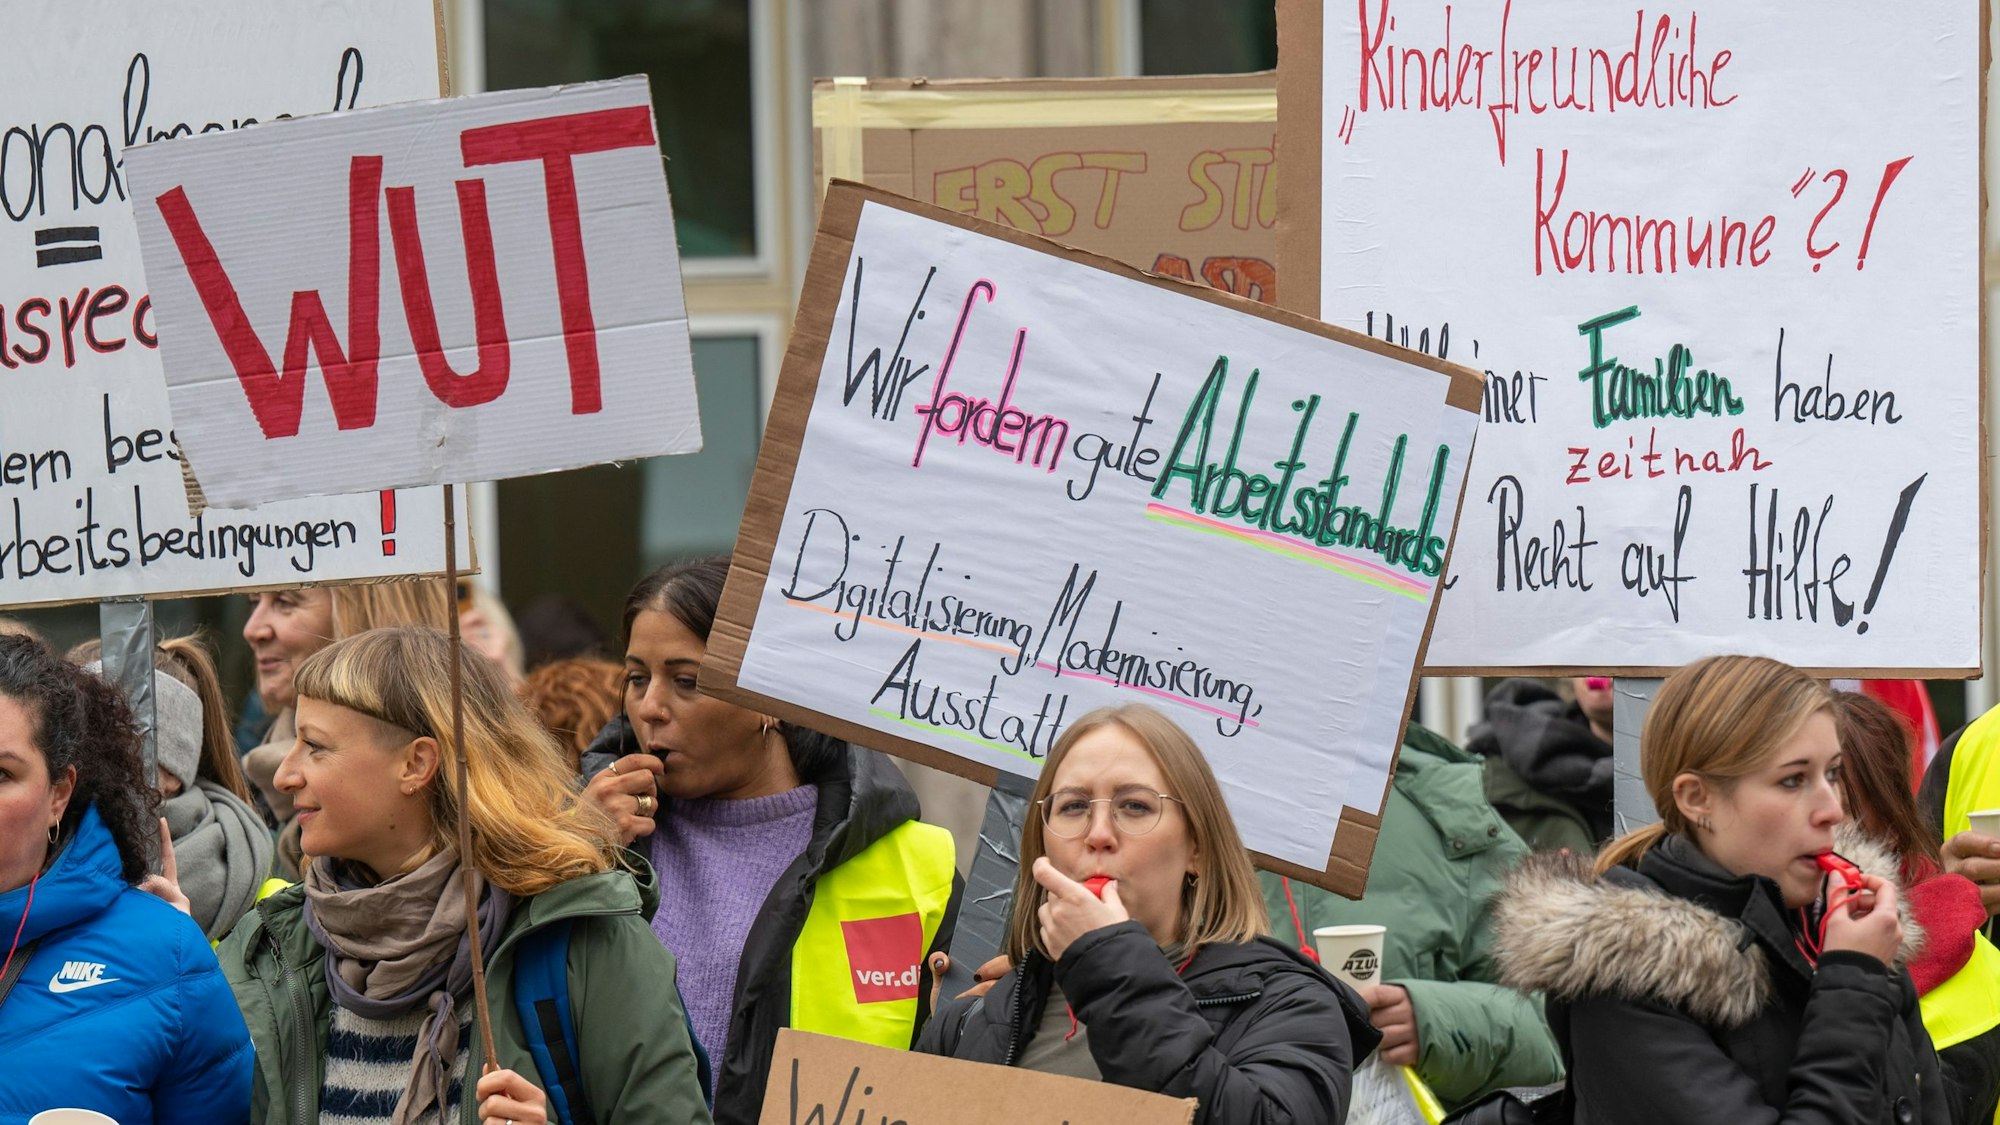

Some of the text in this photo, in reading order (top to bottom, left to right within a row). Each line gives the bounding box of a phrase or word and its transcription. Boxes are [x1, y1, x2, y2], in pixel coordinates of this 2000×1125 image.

[933, 151, 1148, 237] ERST
[155, 105, 656, 441] WUT
[1578, 305, 1744, 428] Familien
[1774, 328, 1903, 424] haben
[843, 255, 937, 421] Wir
[912, 277, 1070, 473] fordern
[1066, 372, 1161, 501] gute
[1150, 354, 1451, 577] Arbeitsstandards
[0, 450, 72, 490] ern
[1565, 427, 1773, 485] zeitnah
[1487, 475, 1599, 592] Recht
[1621, 484, 1696, 623] auf
[58, 961, 106, 980] NIKE
[1341, 958, 1379, 971] AZUL
[789, 1058, 908, 1125] Wi
